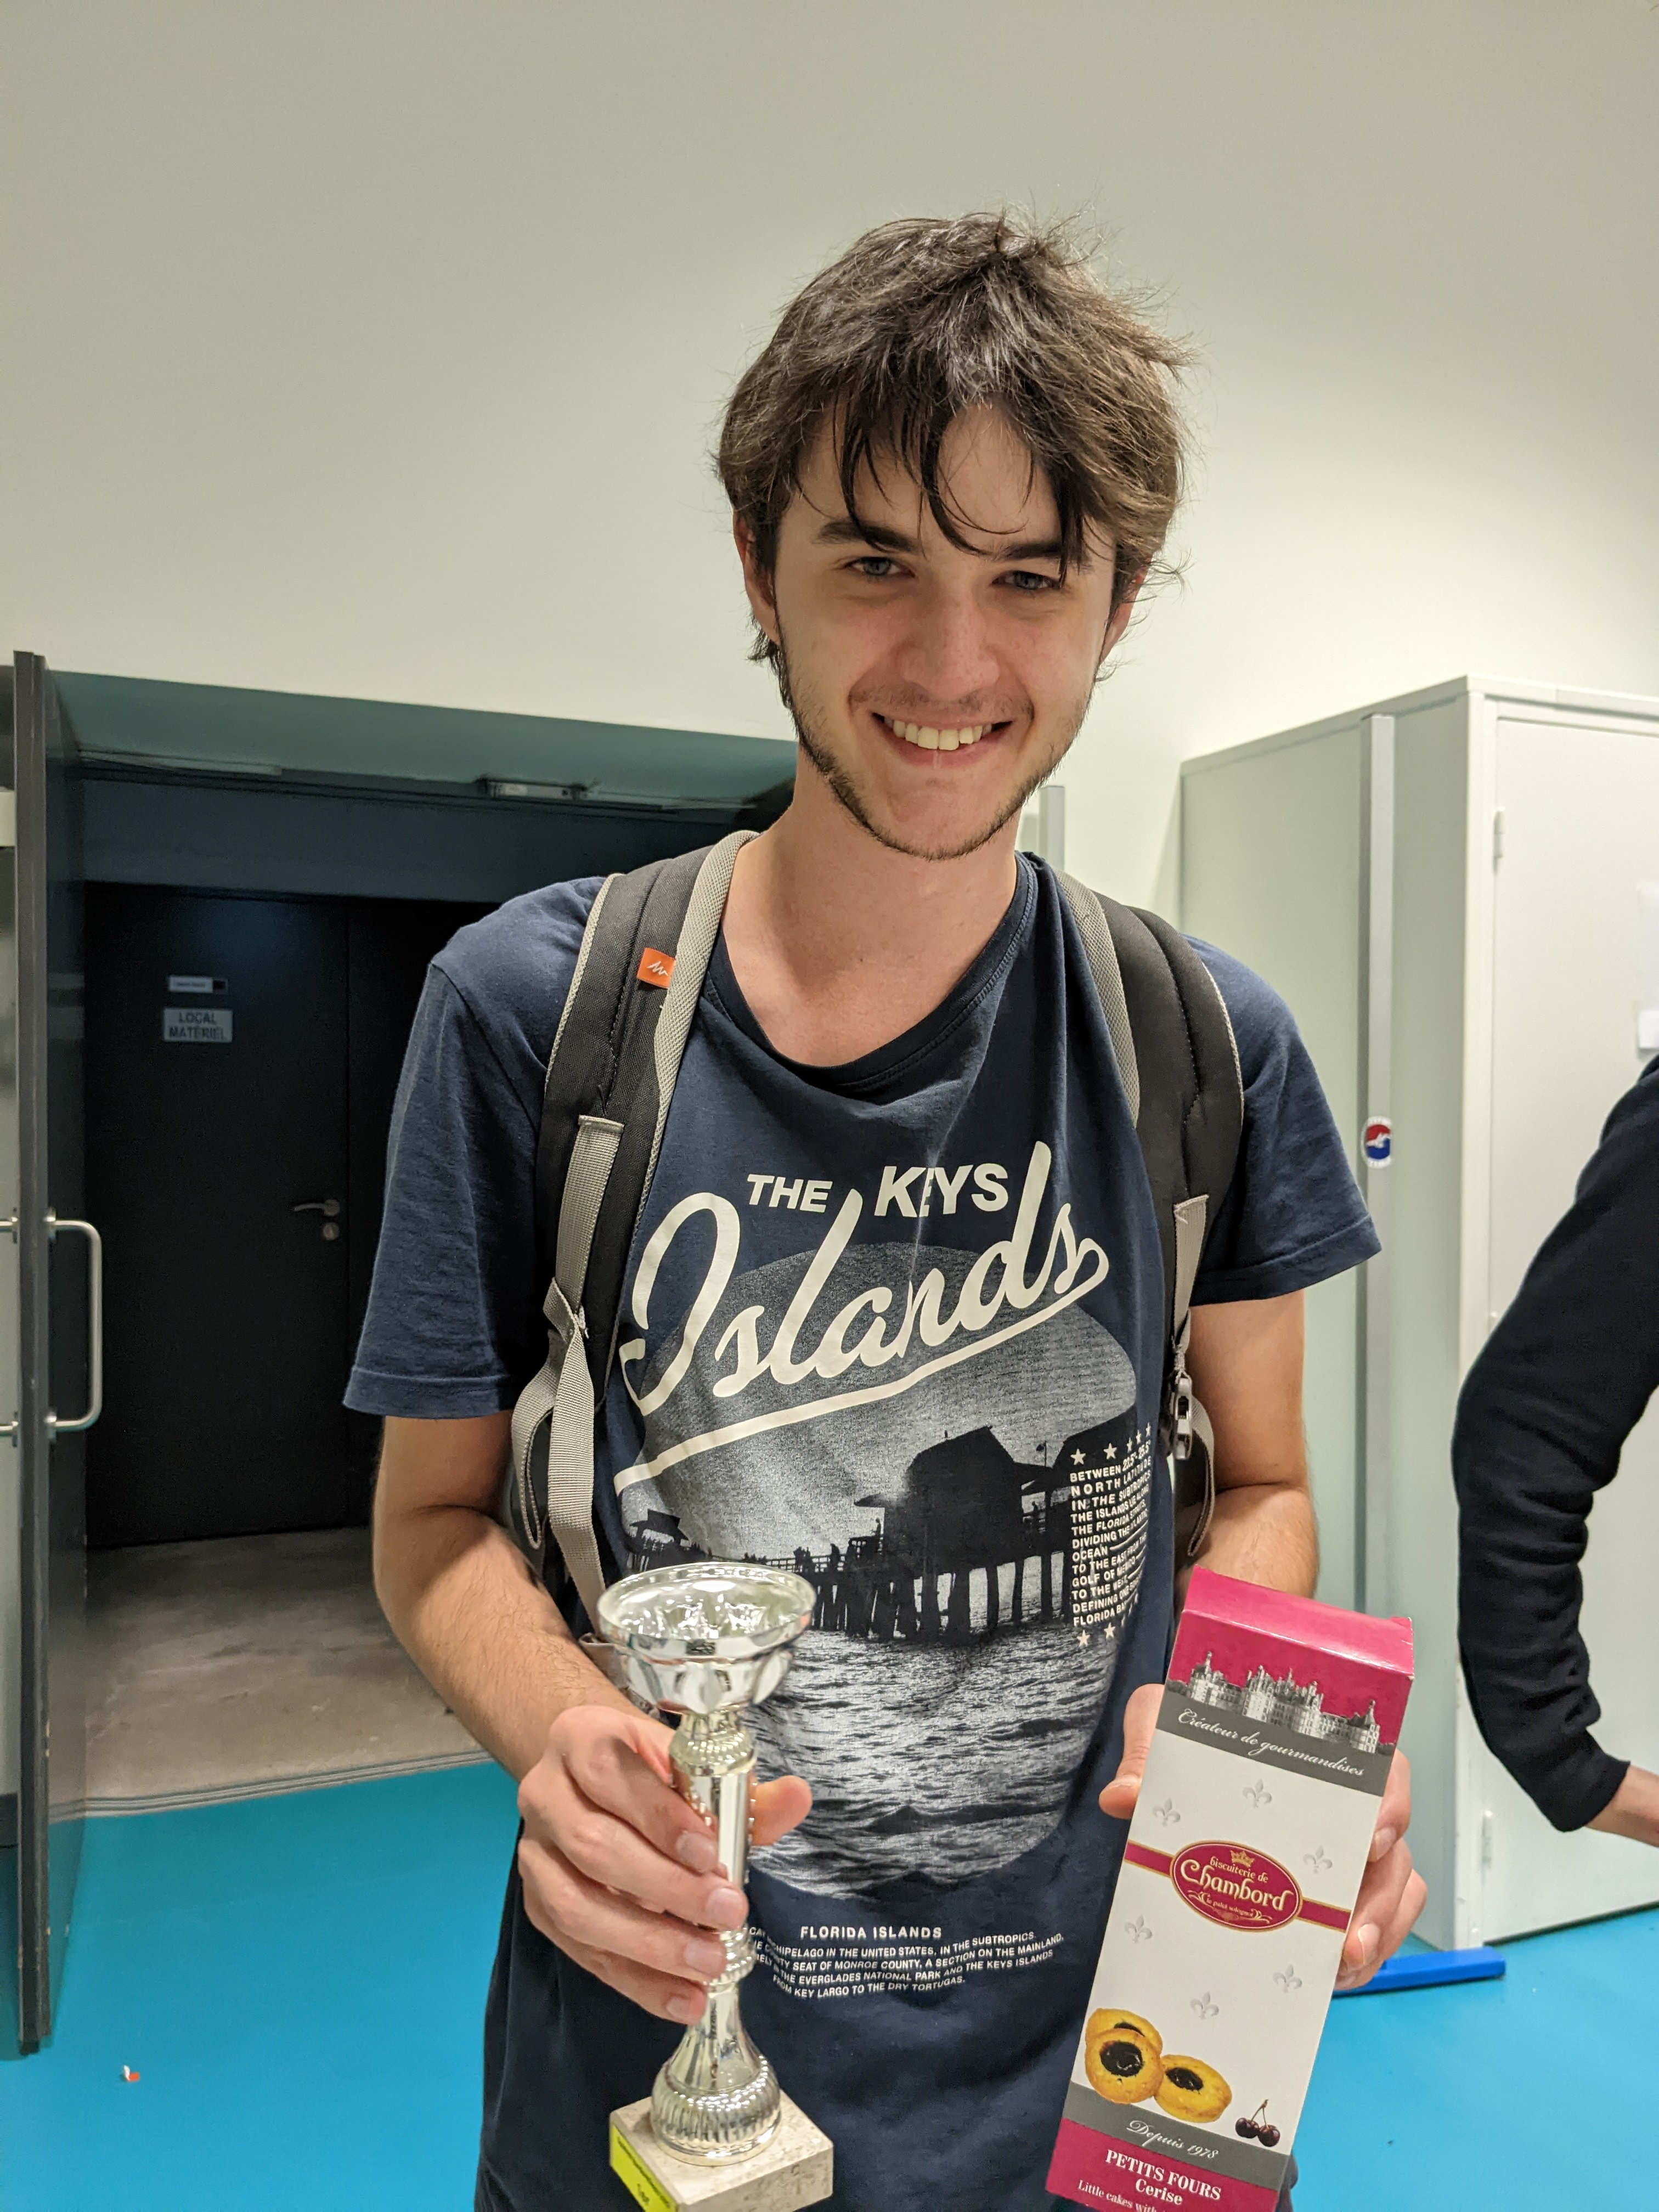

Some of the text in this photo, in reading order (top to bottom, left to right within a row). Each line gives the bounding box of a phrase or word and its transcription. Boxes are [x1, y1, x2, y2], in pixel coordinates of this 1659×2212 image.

[179, 1012, 216, 1025] LOCAL
[747, 1173, 833, 1214] THE
[619, 1141, 1109, 1417] Islands
[1070, 1464, 1121, 1483] BETWEEN
[1071, 1478, 1121, 1498] NORTH
[1071, 1470, 1152, 1511] IN THE SUBTROPICS
[1070, 1511, 1093, 1524] THE
[1096, 1500, 1129, 1519] ISLANDS
[1071, 1524, 1093, 1536] THE
[1096, 1514, 1130, 1532] FLORIDA
[1072, 1531, 1117, 1549] DIVIDING
[1118, 1525, 1130, 1538] THE
[1072, 1545, 1108, 1562] OCEAN
[1072, 1564, 1087, 1575] TO
[1090, 1558, 1109, 1570] THE
[1111, 1550, 1127, 1567] EAST
[1072, 1573, 1101, 1588] GOLF
[1103, 1569, 1115, 1582] OF
[1072, 1589, 1087, 1600] TO
[1091, 1584, 1110, 1597] THE
[1073, 1594, 1118, 1614] DEFINING
[1074, 1608, 1115, 1627] FLORIDA
[1178, 1708, 1363, 1776] Créateur de gourmandises
[1210, 1856, 1268, 1883] biscuiterie de
[1180, 1859, 1294, 1911] Chambord
[800, 1926, 942, 1940] FLORIDA ISLANDS
[826, 1948, 836, 1957] IN
[839, 1948, 858, 1957] THE
[861, 1948, 896, 1958] UNITED
[898, 1946, 937, 1956] STATES,
[940, 1945, 950, 1955] IN
[953, 1939, 969, 1951] THE
[972, 1931, 1036, 1946] SUBTROPICS.
[793, 1961, 817, 1972] SEAT
[820, 1961, 832, 1971] OF
[834, 1960, 877, 1970] MONROE
[881, 1959, 922, 1970] COUNTY,
[925, 1959, 933, 1968] A
[935, 1950, 975, 1967] SECTION
[978, 1949, 992, 1957] ON
[996, 1947, 1014, 1957] THE
[1018, 1933, 1064, 1955] MAINLAND,
[781, 1969, 796, 1984] THE
[799, 1972, 861, 1985] EVERGLADES
[864, 1971, 912, 1981] NATIONAL
[915, 1971, 941, 1981] PARK
[944, 1966, 963, 1975] AND
[966, 1961, 984, 1972] THE
[987, 1960, 1013, 1969] KEYS
[1016, 1949, 1053, 1966] ISLANDS
[773, 1974, 966, 1999] FROM KEY LARGO TO THE DRY TORTUGAS.
[1126, 2120, 1219, 2159] Depuis 1978
[1105, 2149, 1222, 2200] PETITS FOURS
[1077, 2180, 1105, 2198] Little
[1105, 2192, 1133, 2209] cakes
[1135, 2179, 1183, 2205] Cerise
